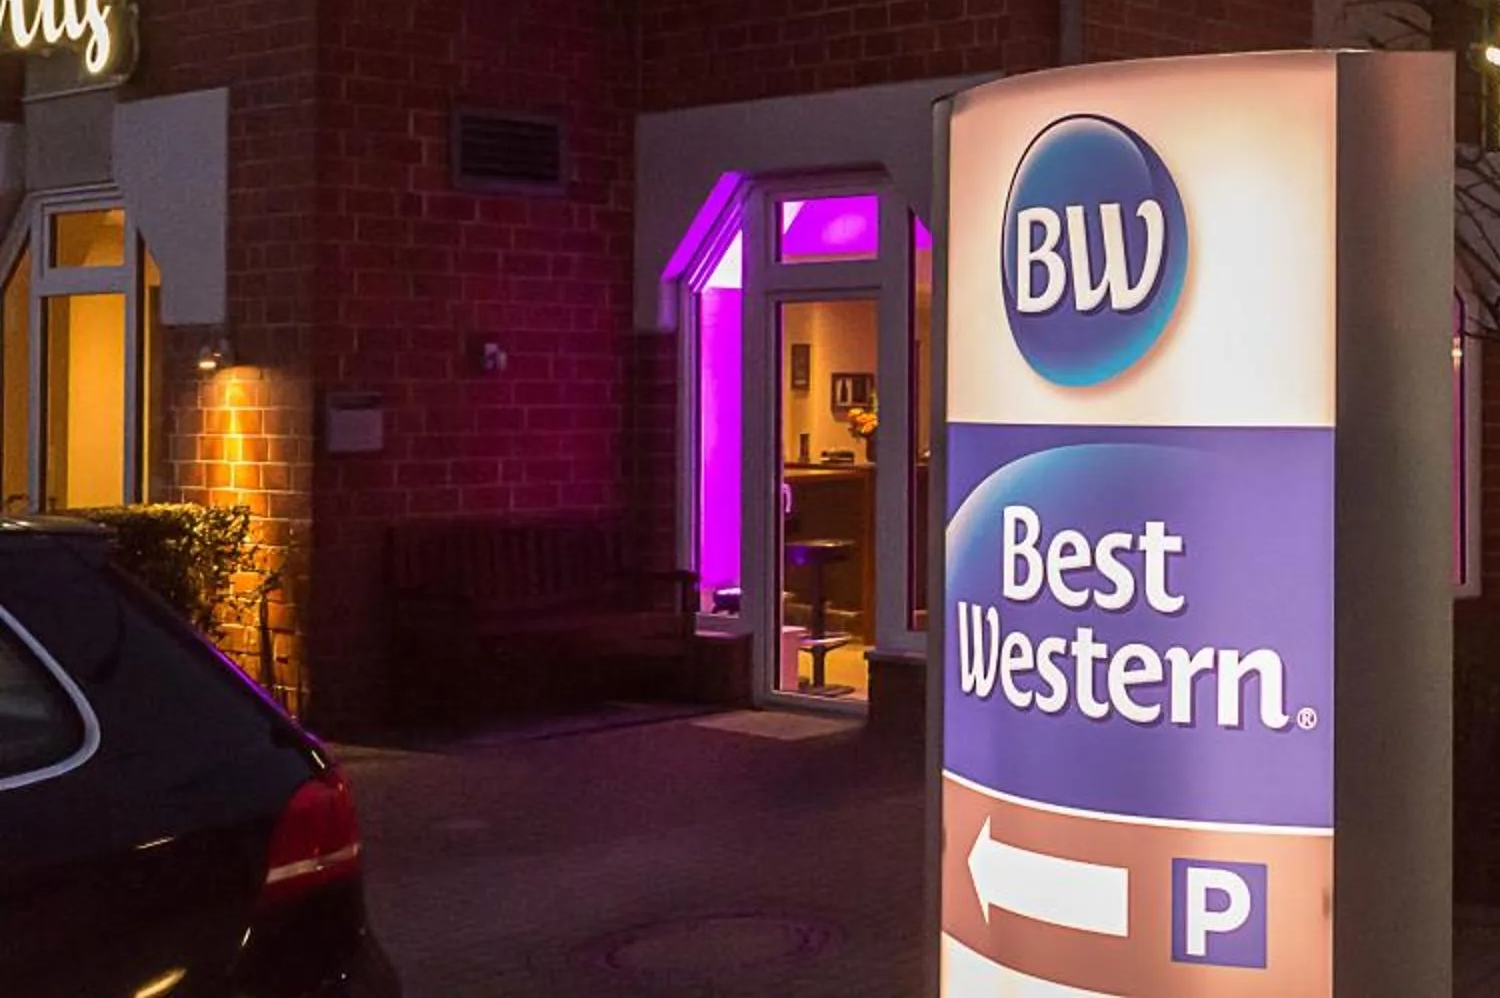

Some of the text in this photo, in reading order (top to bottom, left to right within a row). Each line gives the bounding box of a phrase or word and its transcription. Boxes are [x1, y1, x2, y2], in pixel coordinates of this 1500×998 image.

[1016, 200, 1166, 314] BW
[1002, 504, 1187, 613] Best
[1185, 866, 1252, 957] P
